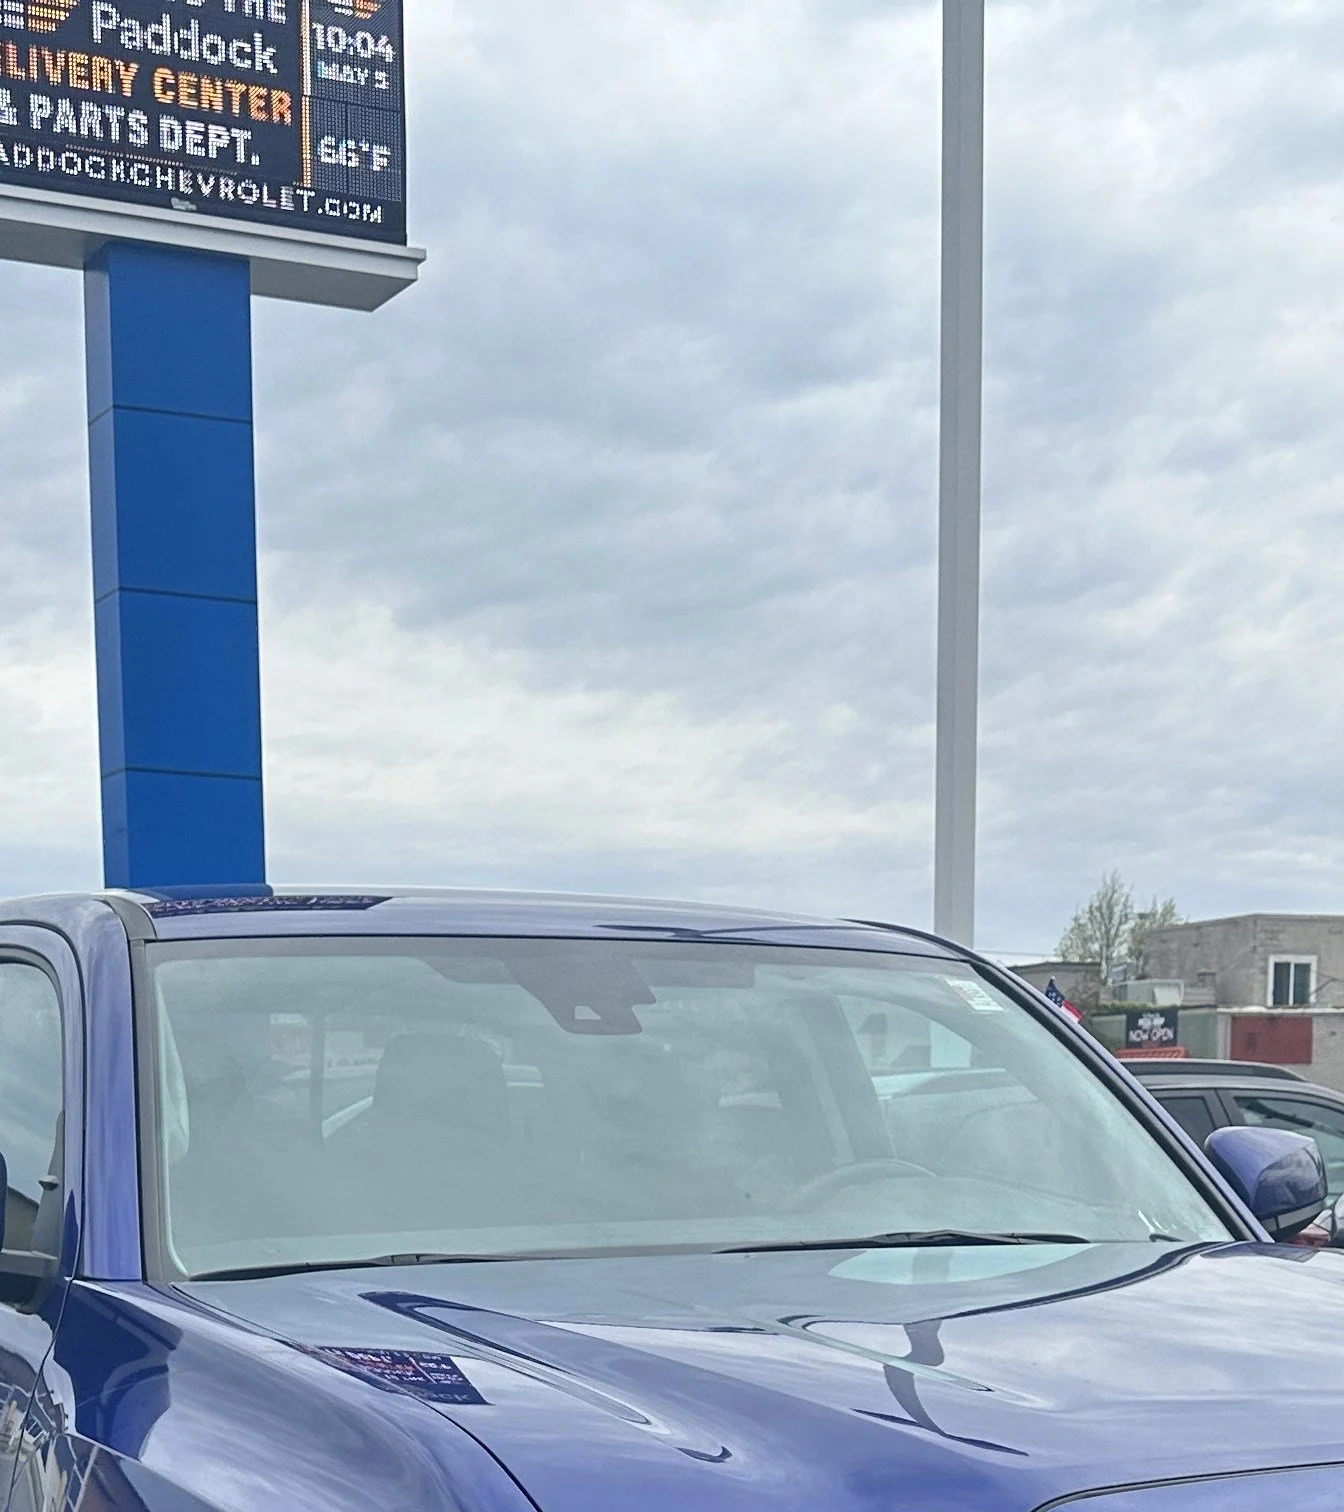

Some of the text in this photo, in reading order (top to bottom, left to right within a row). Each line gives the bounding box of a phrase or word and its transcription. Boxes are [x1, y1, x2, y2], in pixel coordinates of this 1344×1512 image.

[91, 0, 279, 75] Paddock
[312, 21, 396, 63] 10:04
[28, 92, 149, 147] PARTS
[158, 114, 261, 166] DEPT.
[152, 66, 293, 126] CENTER
